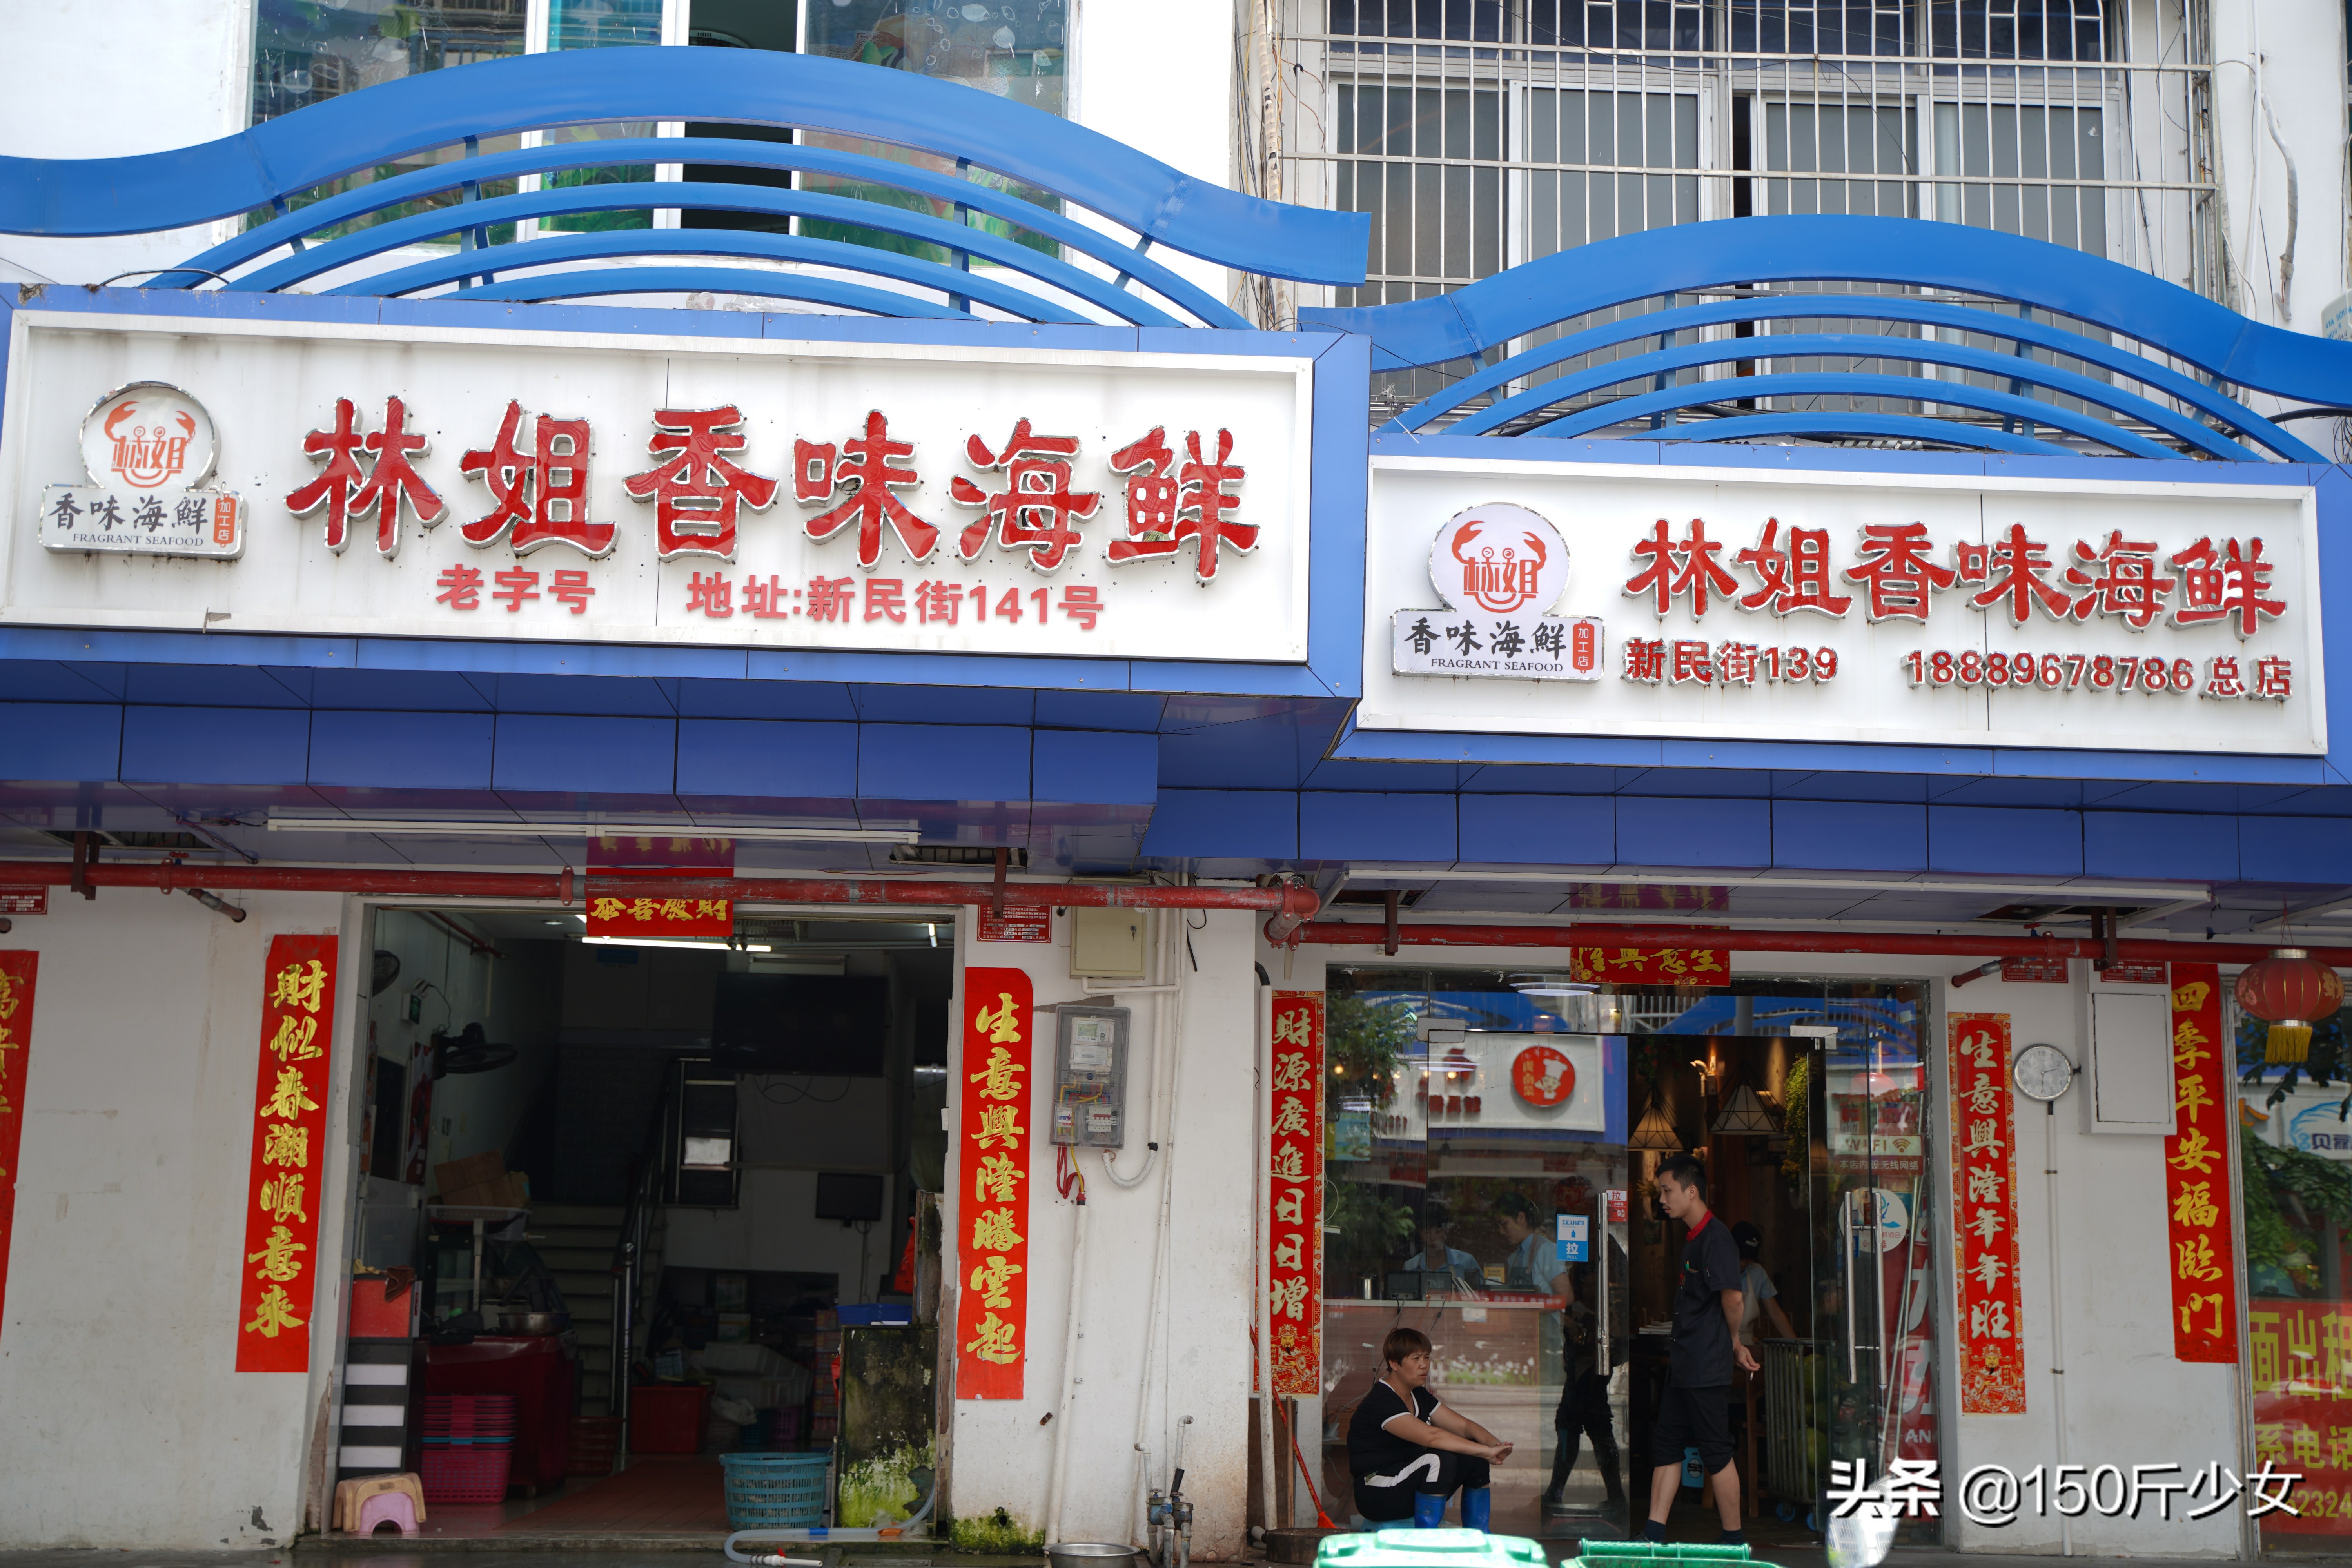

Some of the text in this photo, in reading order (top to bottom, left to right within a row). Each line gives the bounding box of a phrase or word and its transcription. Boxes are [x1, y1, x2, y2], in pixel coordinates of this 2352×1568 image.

[111, 431, 186, 471] 林姐
[283, 394, 1261, 586] 林姐香味海鲜
[73, 534, 203, 546] FRAGRANT SEAFOOD
[218, 501, 231, 541] 加工店
[437, 564, 596, 614] 老字号
[1464, 554, 1539, 594] 林姐
[1622, 515, 2287, 637] 林姐香味海鲜
[686, 572, 1104, 630] 地址:新民街141号
[1431, 659, 1563, 672] FRAGRANT SEAFOOD
[1577, 627, 1589, 666] 加工店
[1623, 637, 2292, 702] 新民街139 18889678786 总店
[1840, 1160, 1918, 1170] 本店内设无线网络
[1612, 1191, 1621, 1200] 拉
[1566, 1242, 1578, 1254] 拉
